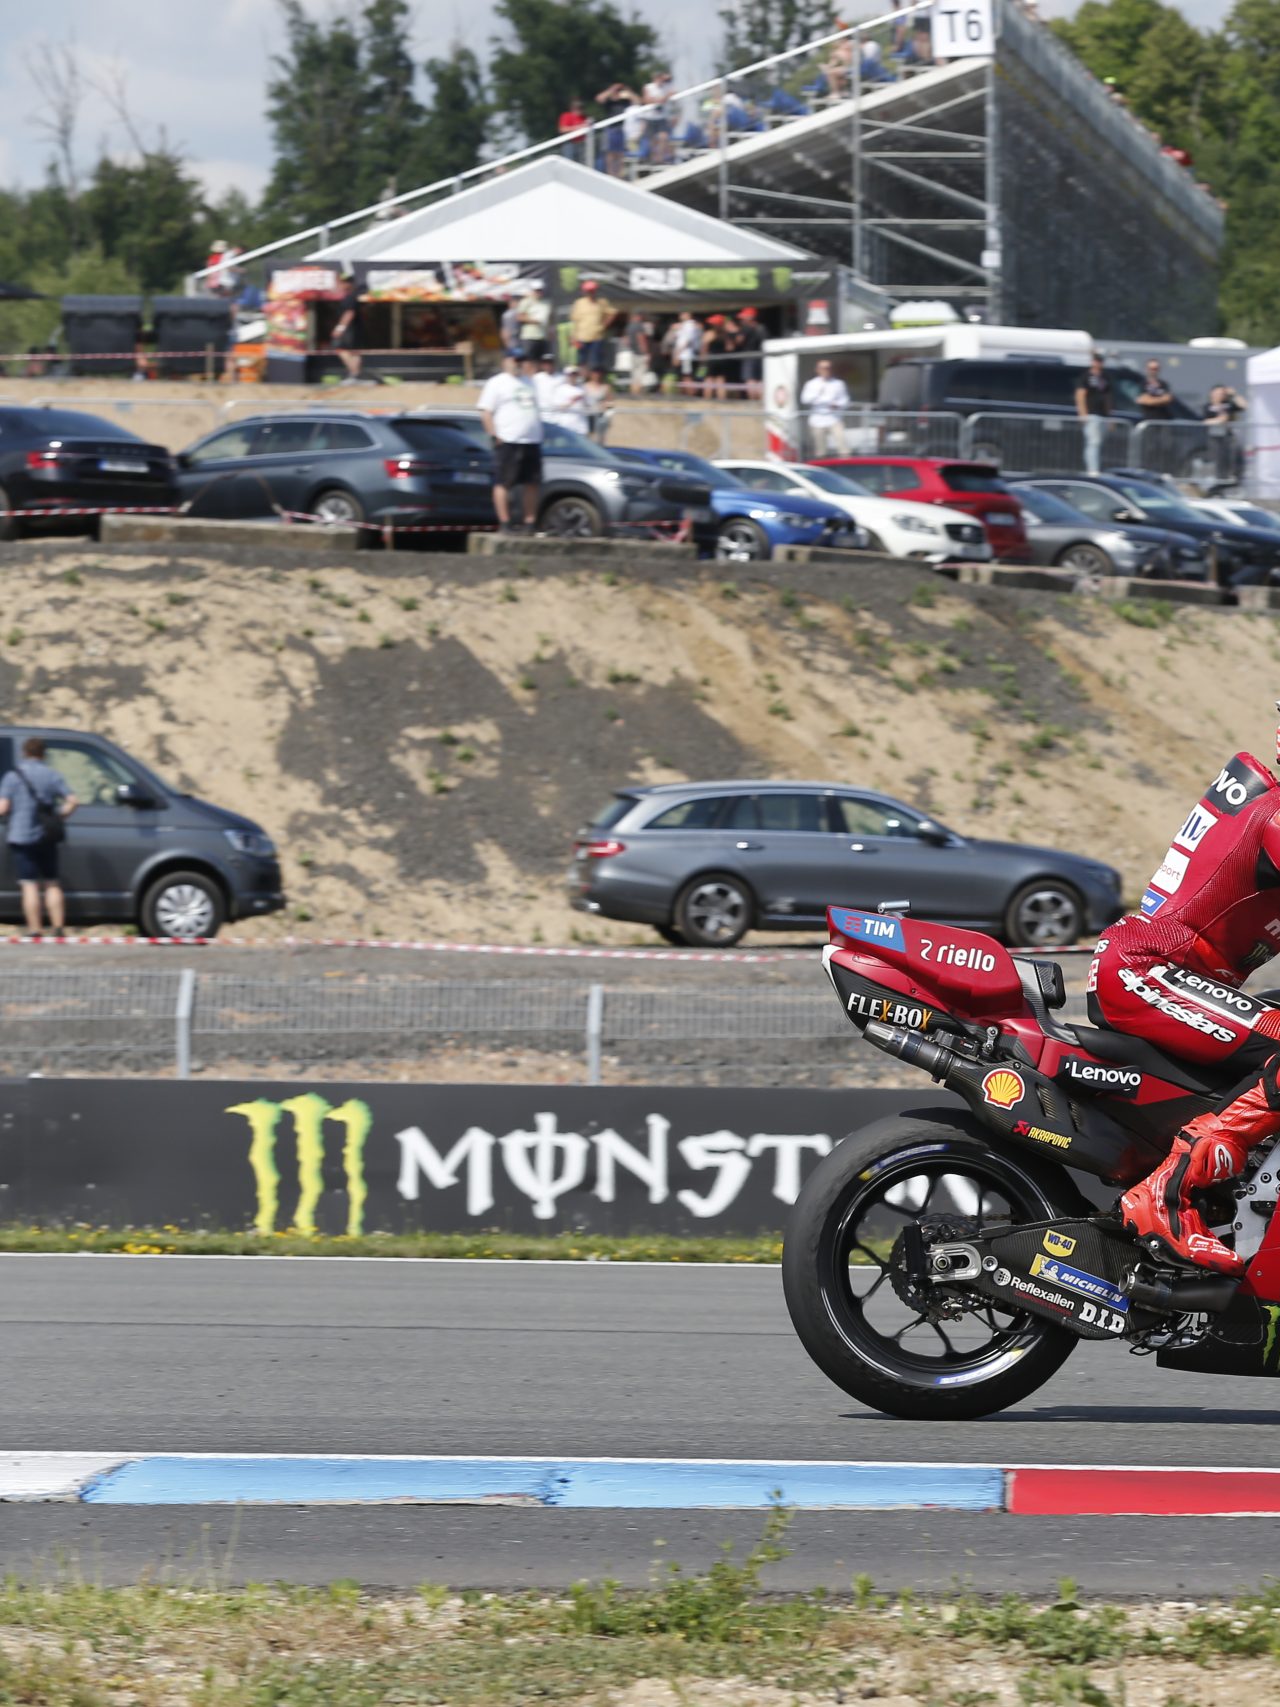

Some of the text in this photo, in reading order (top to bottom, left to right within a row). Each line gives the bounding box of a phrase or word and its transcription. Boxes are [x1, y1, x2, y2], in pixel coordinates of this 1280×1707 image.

[939, 9, 984, 42] T6
[864, 919, 895, 938] TIM
[937, 944, 995, 972] riello
[1118, 968, 1237, 1042] alpinestars
[1174, 969, 1253, 1011] Lenovo
[847, 992, 933, 1031] FLEX-BOX
[1071, 1061, 1141, 1086] Lenovo
[396, 1112, 835, 1219] MONST
[1047, 1232, 1073, 1250] WD-40
[1010, 1276, 1075, 1310] Reflexallen
[1060, 1272, 1123, 1303] MICHELIN
[1078, 1301, 1126, 1334] D.I.D
